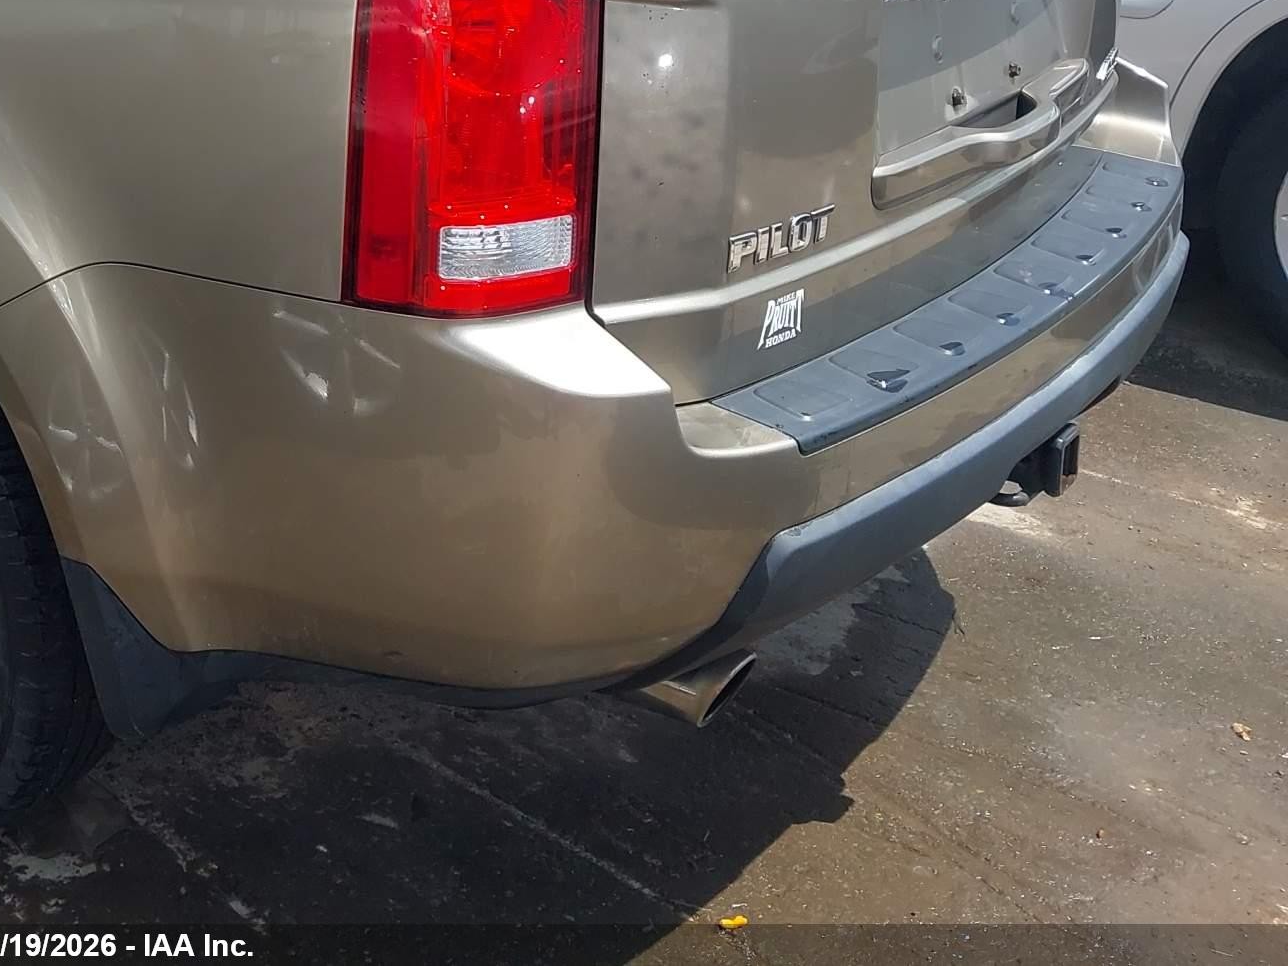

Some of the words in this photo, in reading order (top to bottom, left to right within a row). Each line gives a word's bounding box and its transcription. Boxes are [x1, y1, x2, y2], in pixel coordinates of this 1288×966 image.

[727, 204, 835, 274] PILOT
[776, 291, 796, 305] MIKE
[757, 288, 805, 350] PRUITT
[765, 328, 797, 348] HONDA
